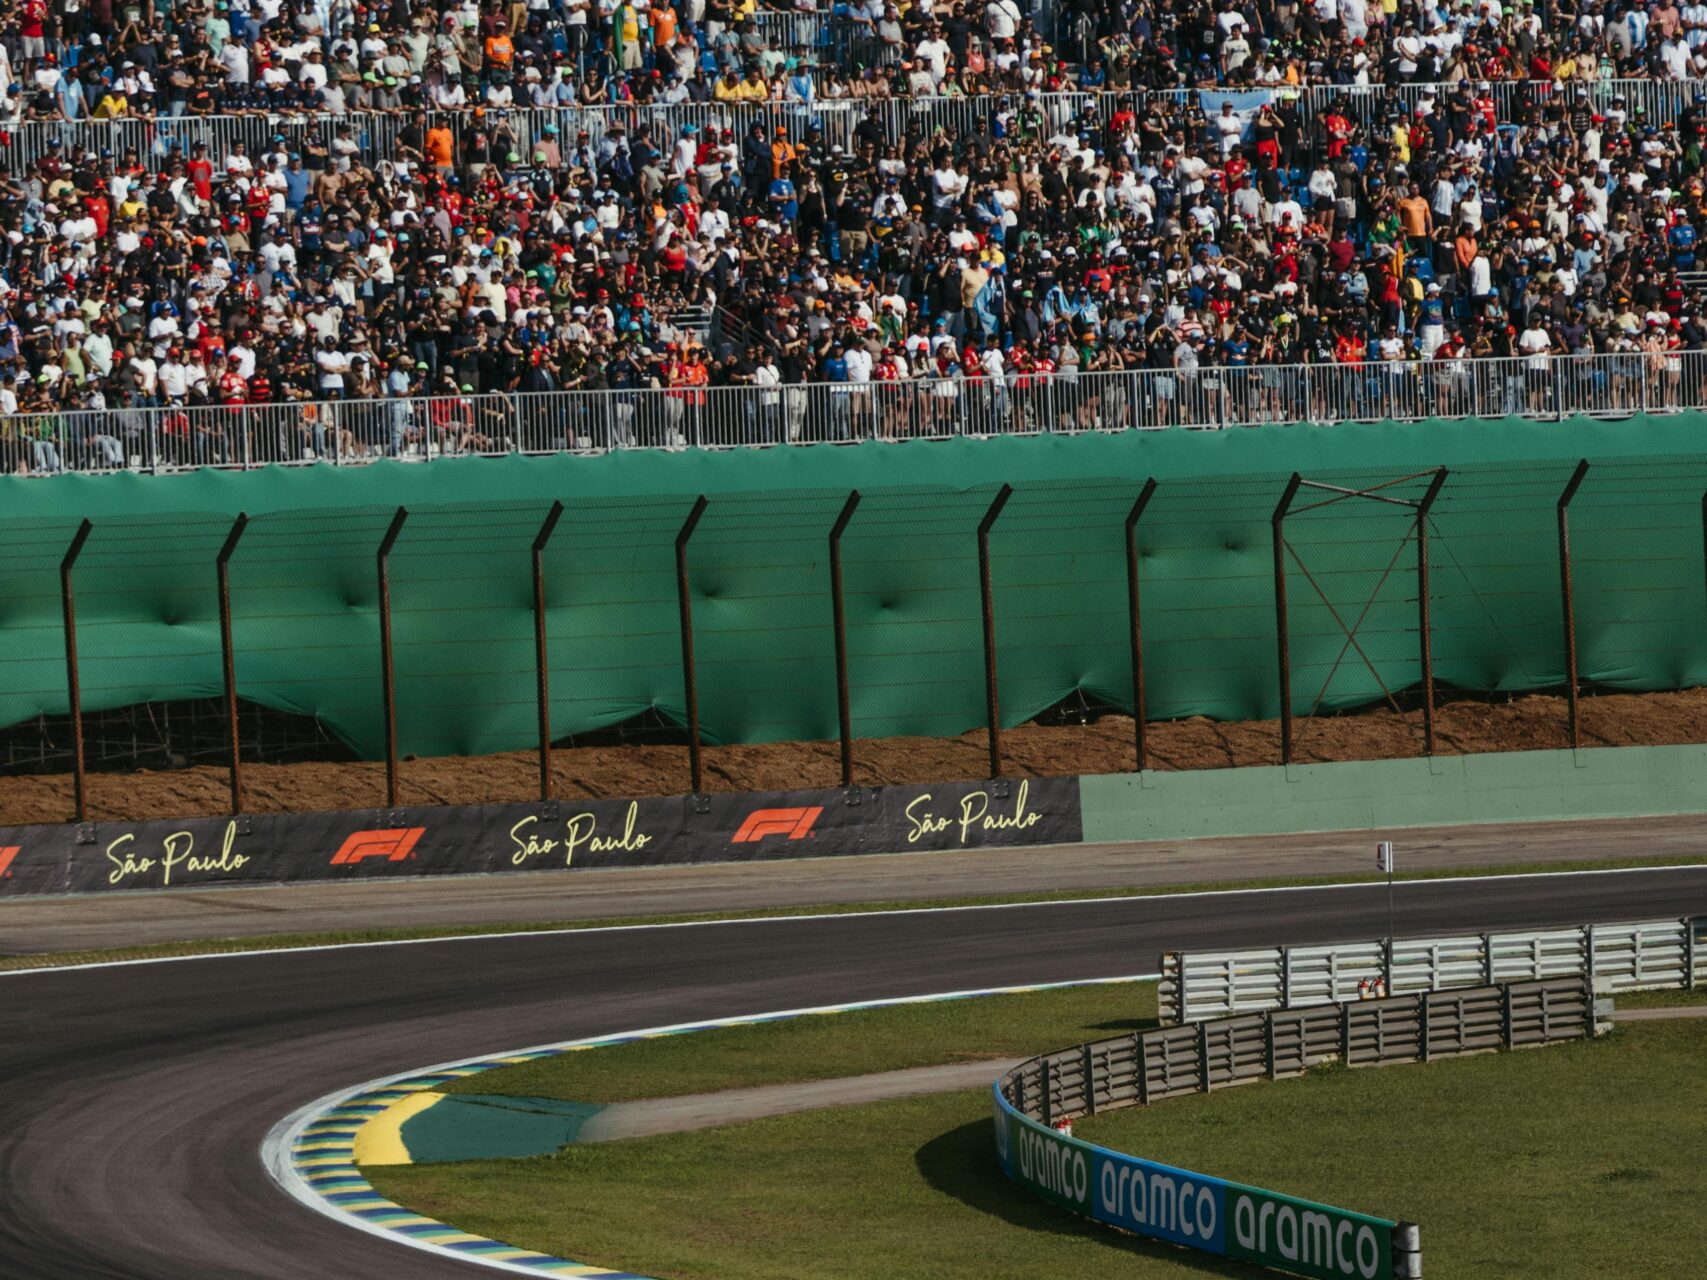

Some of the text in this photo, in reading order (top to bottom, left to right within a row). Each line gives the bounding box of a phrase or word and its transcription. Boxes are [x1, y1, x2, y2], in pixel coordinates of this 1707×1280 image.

[510, 800, 652, 865] São Paulo
[731, 806, 825, 843] F1
[906, 778, 1042, 843] São Paulo
[106, 820, 250, 885] São Paulo
[329, 827, 427, 865] F1
[1020, 1126, 1087, 1203] aramco
[1101, 1160, 1217, 1241] aramco
[1234, 1195, 1380, 1280] aramco
